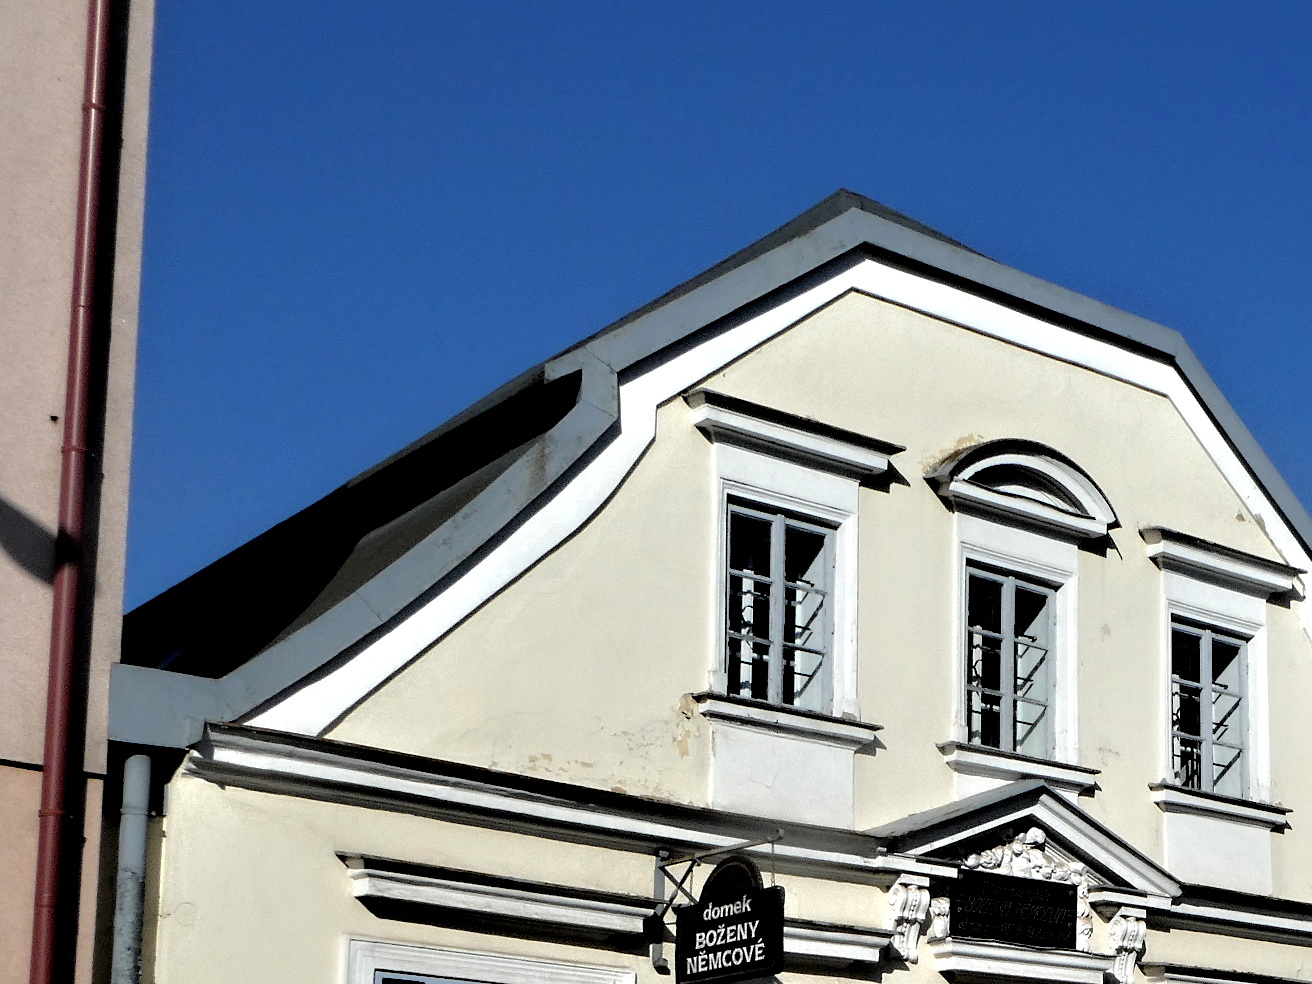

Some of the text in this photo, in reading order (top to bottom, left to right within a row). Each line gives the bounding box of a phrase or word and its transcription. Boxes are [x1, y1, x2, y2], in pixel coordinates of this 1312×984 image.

[703, 894, 752, 921] domek
[695, 920, 760, 950] BOŽENY
[686, 937, 766, 975] NĚMCOVÉ
